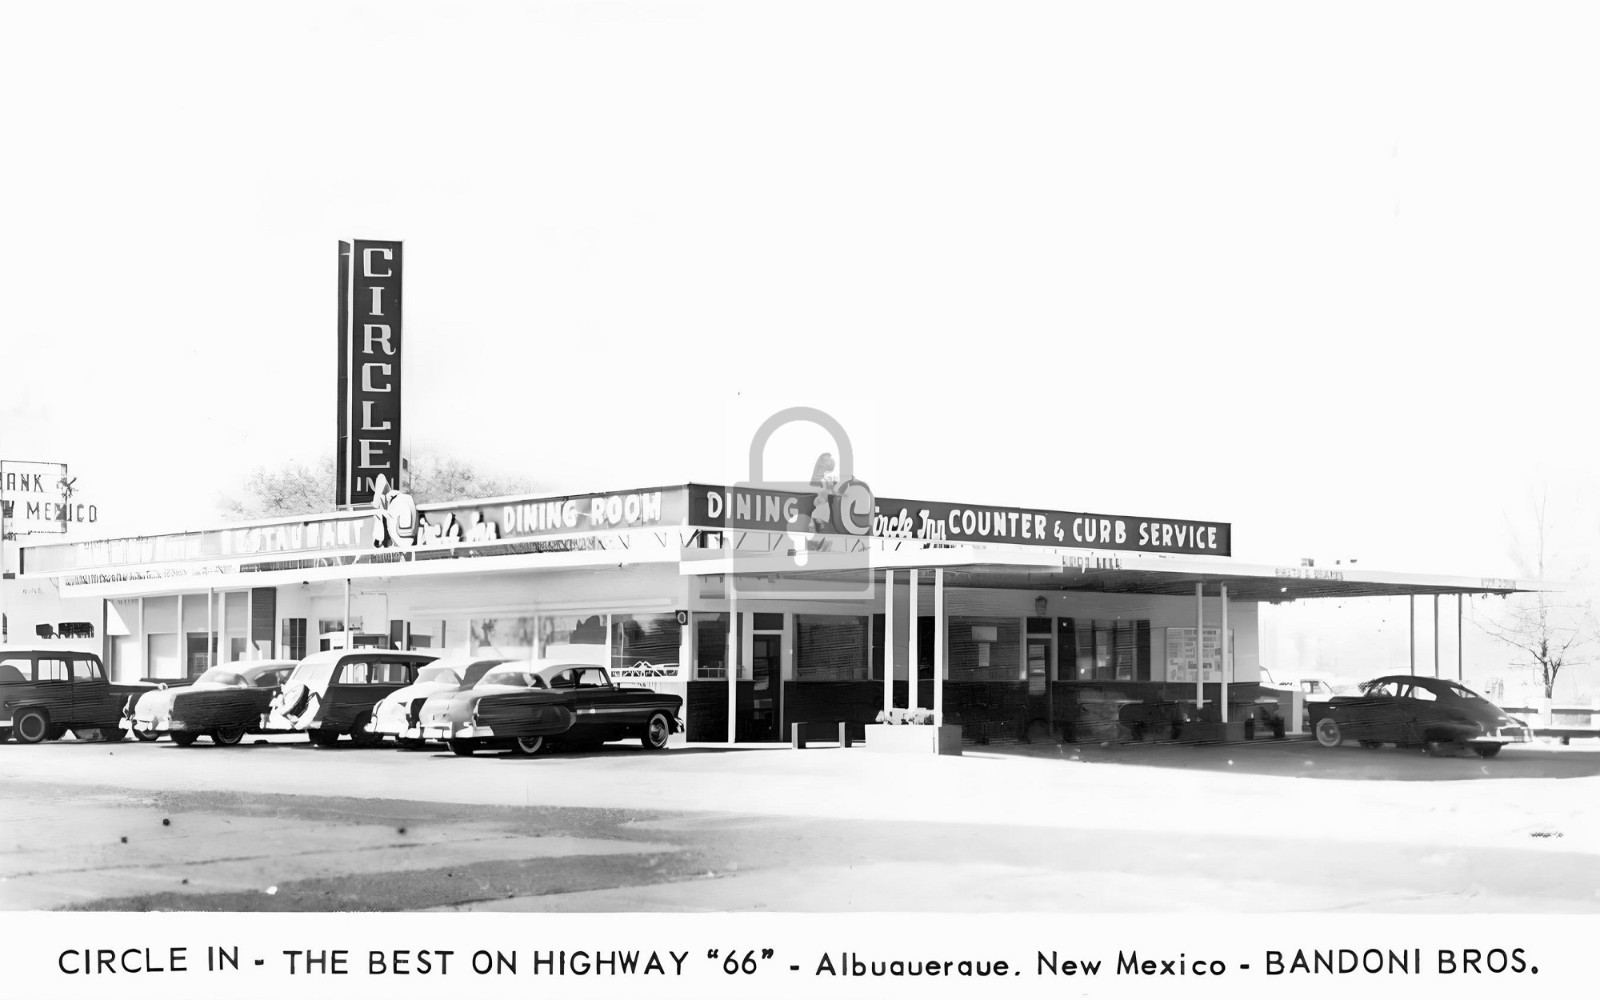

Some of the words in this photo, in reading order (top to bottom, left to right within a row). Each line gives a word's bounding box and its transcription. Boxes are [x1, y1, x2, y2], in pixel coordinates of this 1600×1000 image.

[357, 248, 396, 469] CIRCLE
[0, 472, 43, 493] ANK
[503, 502, 577, 534] DINING
[591, 491, 662, 525] ROOM
[706, 491, 799, 523] DINING
[841, 484, 913, 538] Circle
[917, 509, 947, 540] Inn
[948, 509, 1047, 540] COUNTER
[1053, 519, 1065, 542] &
[1072, 517, 1127, 545] CURB
[1138, 522, 1218, 550] SERVICE
